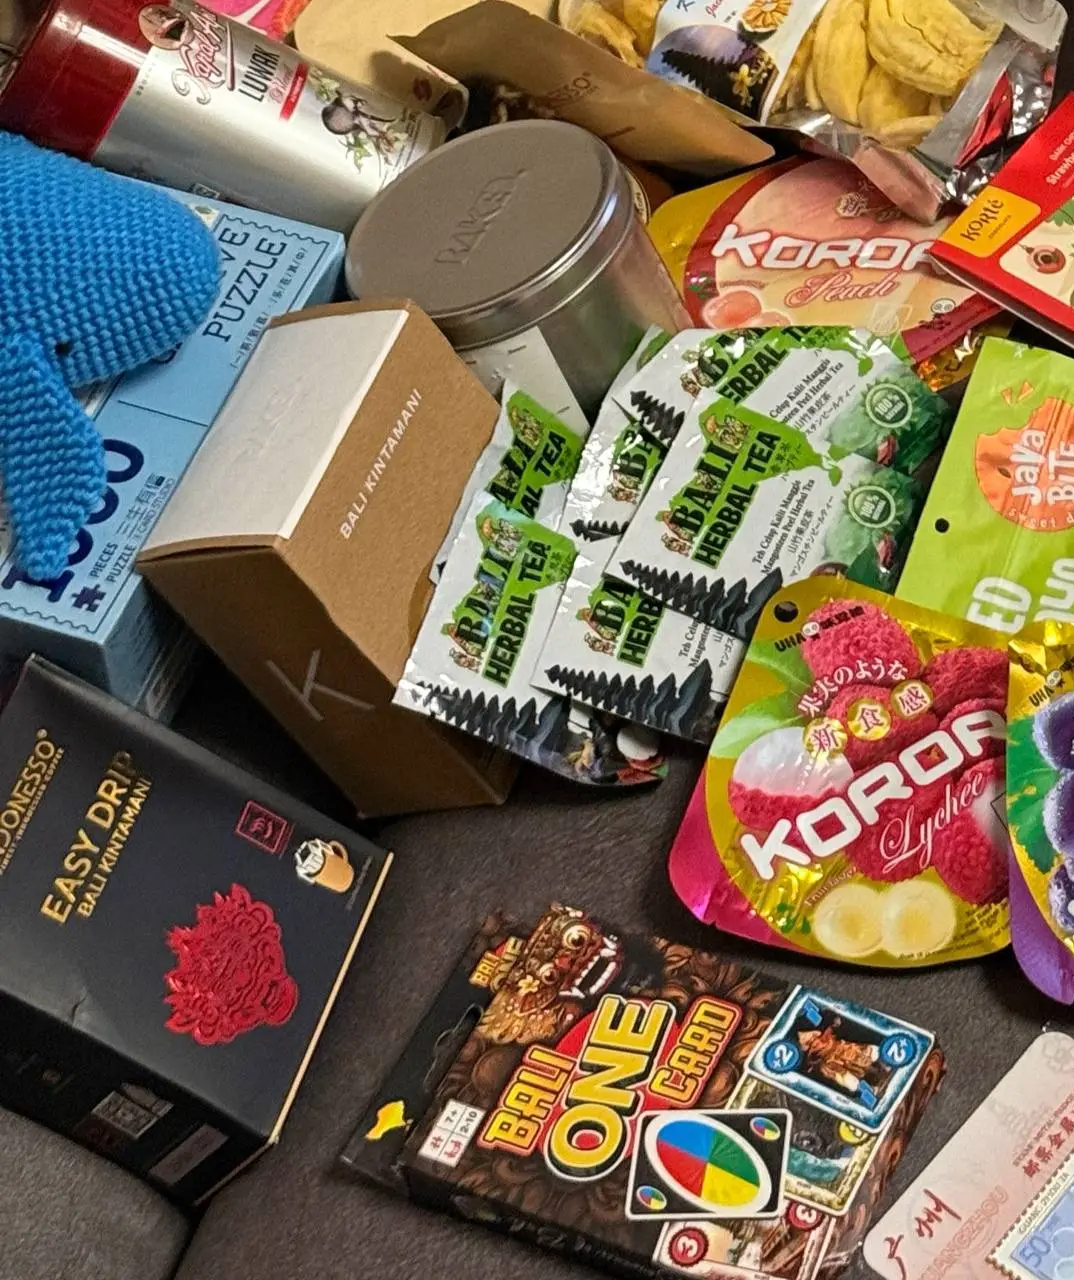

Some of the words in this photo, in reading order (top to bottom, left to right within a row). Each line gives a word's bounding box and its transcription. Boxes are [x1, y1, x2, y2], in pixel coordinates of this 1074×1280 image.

[239, 45, 281, 102] LUWAK
[204, 237, 287, 342] PUZZLE
[712, 224, 937, 270] KOROR
[785, 272, 898, 308] Peach
[340, 496, 368, 539] BALI
[365, 389, 423, 495] KINTAMANI
[535, 431, 566, 478] TEA
[673, 443, 739, 538] BALI
[743, 431, 781, 473] TEA
[91, 543, 118, 578] PIECES
[109, 544, 137, 583] PUZZLE
[519, 540, 551, 582] TEA
[694, 483, 759, 569] HERBAL
[485, 591, 537, 687] HERBAL
[619, 592, 664, 666] HERB
[966, 577, 1032, 635] ED
[0, 740, 56, 848] DONESSO
[40, 828, 100, 924] EASY
[86, 750, 137, 829] DRIP
[880, 772, 985, 874] Lychee
[77, 873, 108, 917] BALI
[99, 778, 152, 873] KINTAMANI
[469, 950, 500, 988] BALI
[551, 996, 672, 1172] ONE
[651, 999, 737, 1104] CARD
[484, 1048, 577, 1151] BALI
